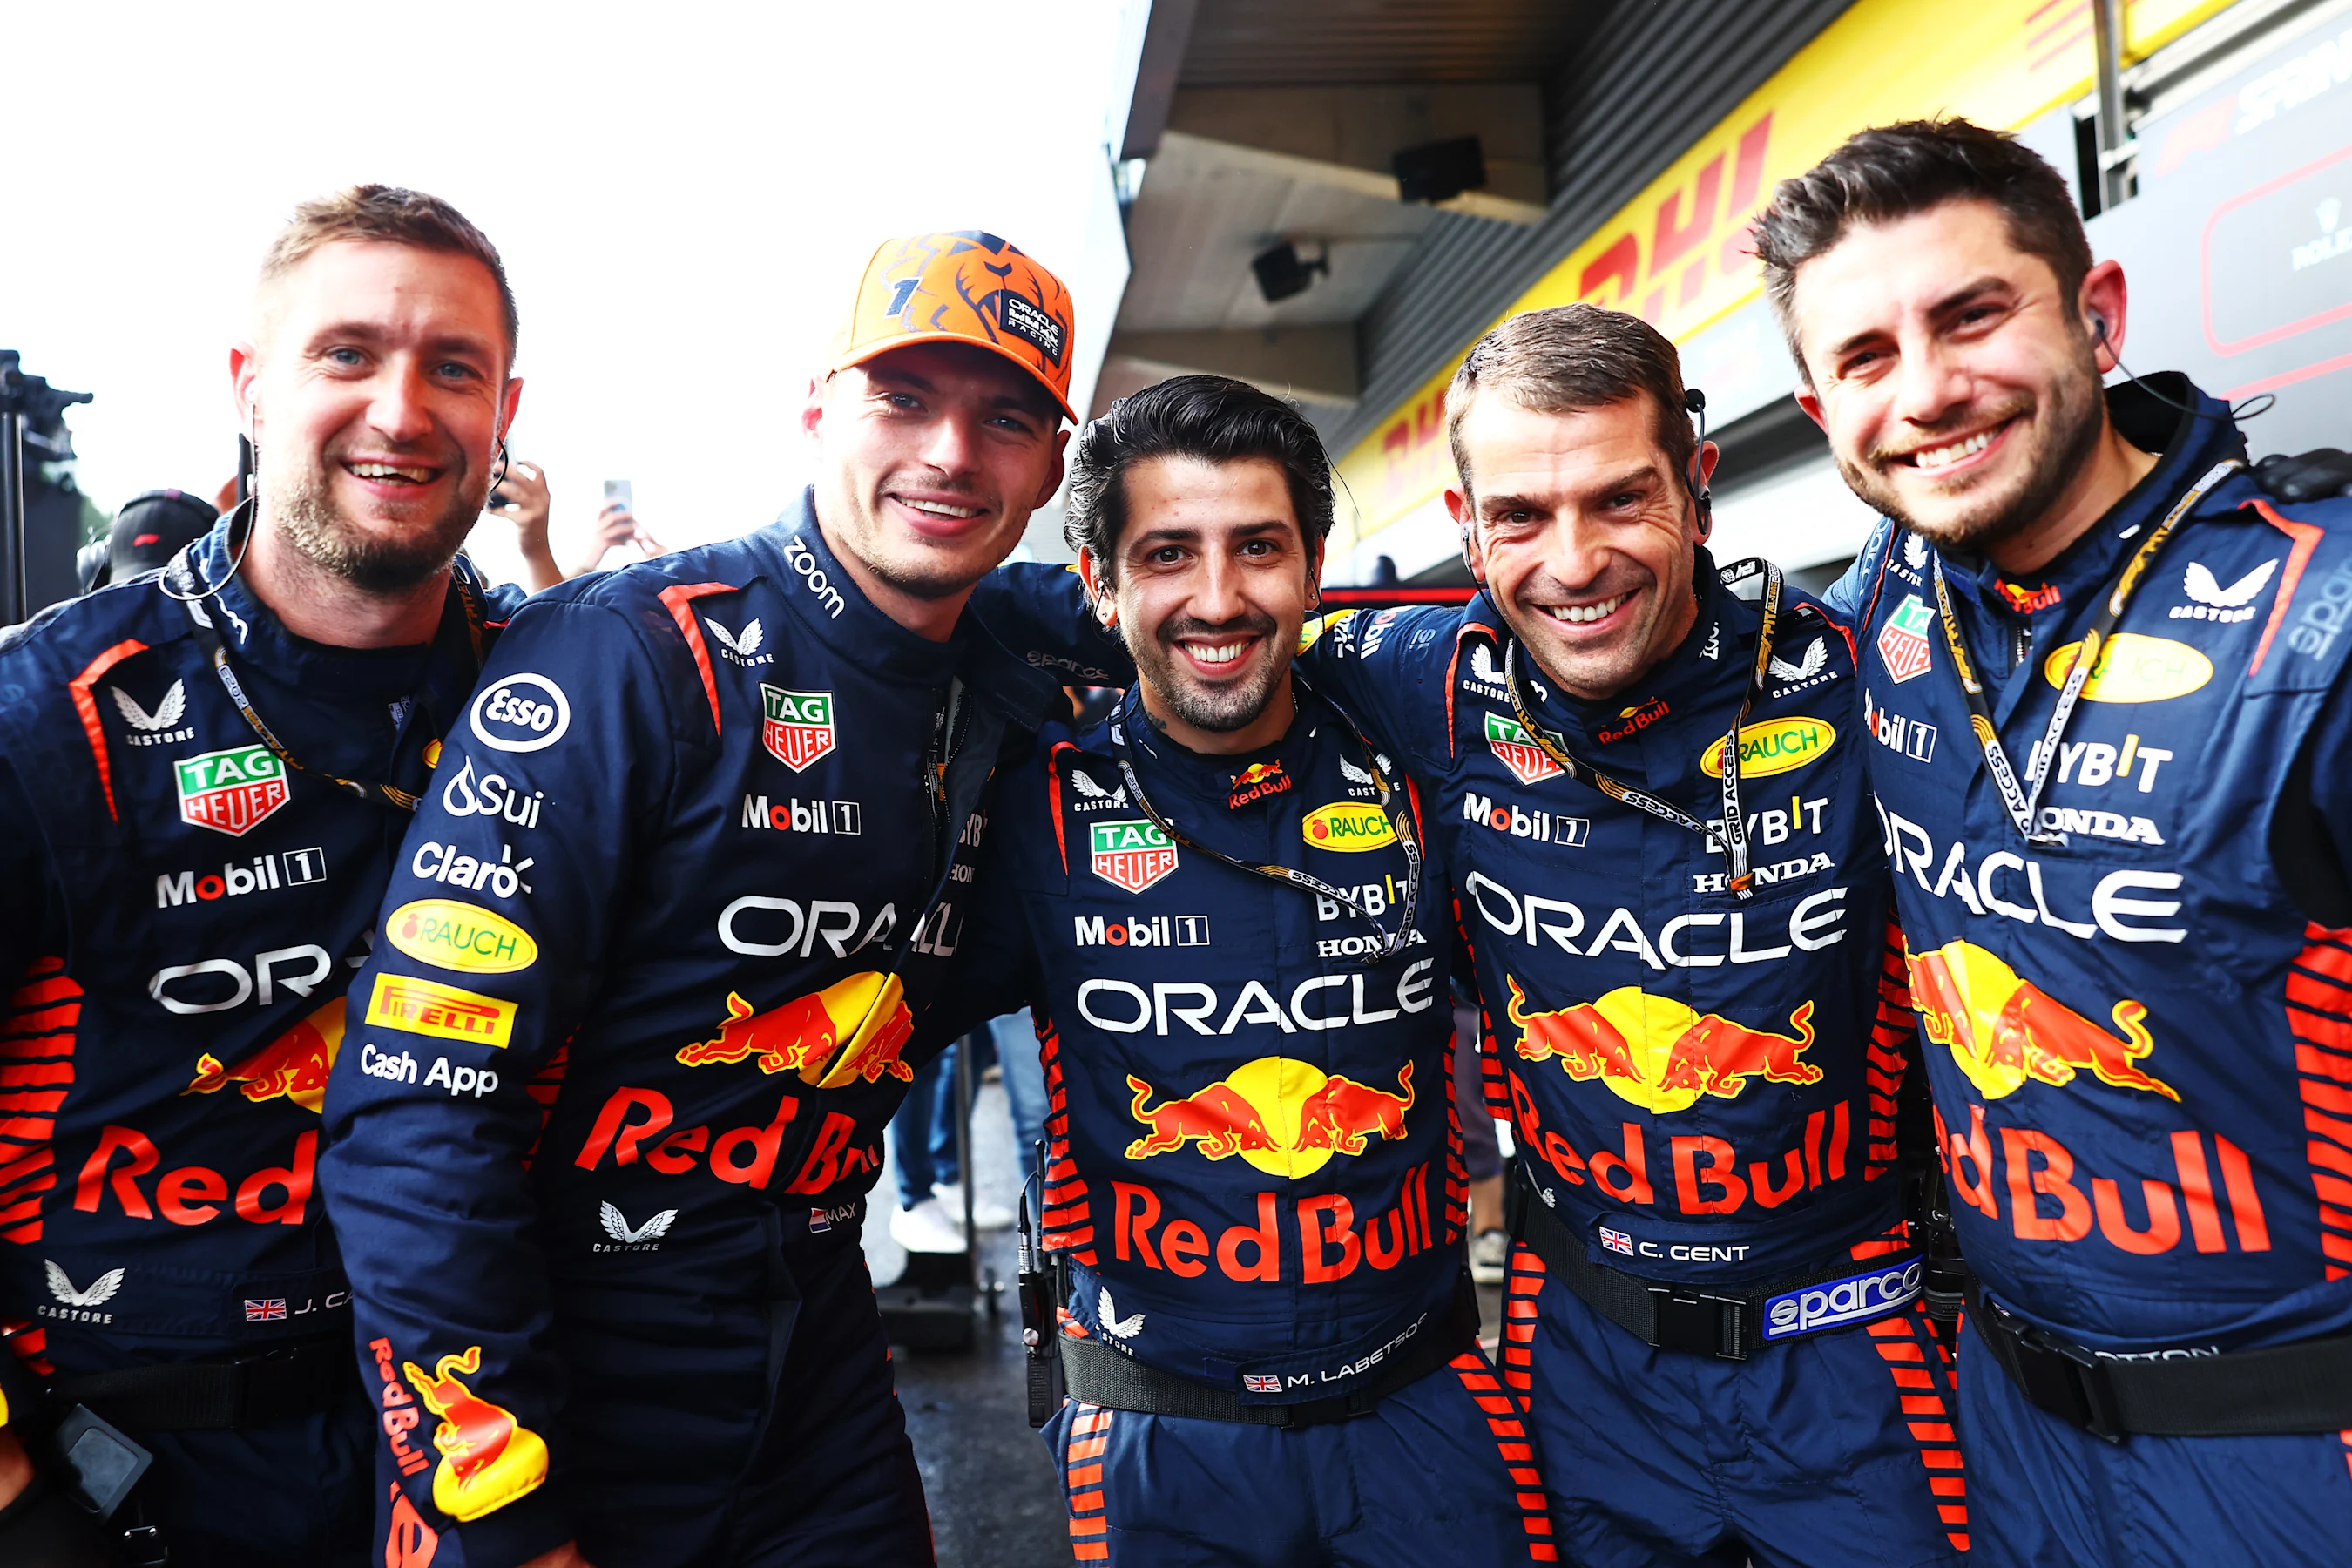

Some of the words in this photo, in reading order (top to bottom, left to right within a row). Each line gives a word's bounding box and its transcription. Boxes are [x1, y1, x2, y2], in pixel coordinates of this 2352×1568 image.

[884, 277, 922, 318] 1
[1009, 299, 1058, 336] ORACLE
[1008, 320, 1058, 355] RACING
[1009, 308, 1025, 322] Red
[1024, 314, 1039, 330] Bull
[784, 537, 845, 618] zoom
[1762, 608, 1776, 637] PIT
[721, 648, 774, 667] CASTORE
[1882, 628, 1931, 674] HEUE
[1463, 680, 1511, 703] CASTORE
[1772, 671, 1838, 698] CASTORE
[767, 693, 824, 721] TAG
[1598, 720, 1635, 744] Red
[1634, 700, 1670, 730] Bull
[2047, 673, 2082, 747] ACCESS
[763, 723, 829, 765] HEUER
[1490, 720, 1540, 747] TA
[184, 748, 273, 789] TAG
[1724, 734, 1736, 801] ACCESS
[1989, 745, 2026, 813] ACCESS
[187, 780, 283, 830] HEUER
[478, 774, 544, 828] Sui
[1228, 781, 1259, 809] Red
[1259, 775, 1292, 800] Bull
[1348, 782, 1401, 796] CASTE
[1626, 793, 1690, 826] ACCESS
[741, 794, 828, 833] Mobil
[1463, 792, 1551, 841] Mobil
[1727, 805, 1744, 845] GRID
[2040, 803, 2166, 845] ONDA
[1096, 826, 1167, 848] TAG
[157, 855, 277, 909] Mobil
[412, 841, 520, 899] Claro
[1097, 848, 1173, 891] HEUER
[1403, 843, 1419, 902] ACCESS
[1693, 852, 1835, 893] HNDA
[422, 914, 517, 962] RAUCH
[1075, 916, 1169, 947] Mobil
[1398, 906, 1414, 940] GRID
[1465, 871, 1848, 970] ORACLE
[1316, 929, 1428, 957] HONA
[380, 985, 499, 1036] PIRELLI
[1078, 957, 1435, 1035] ORACLE
[361, 1044, 416, 1084] Cash
[423, 1055, 498, 1098] App
[574, 1085, 798, 1191] Red
[1508, 1068, 1654, 1206] Red
[1670, 1099, 1851, 1215] Bull
[72, 1124, 318, 1226] Red
[2000, 1129, 2272, 1254] Bull
[825, 1202, 855, 1222] MAX
[1111, 1180, 1280, 1282] Red
[1297, 1161, 1432, 1284] Bull
[593, 1242, 660, 1253] CASTORE
[1639, 1243, 1663, 1259] C.
[1670, 1246, 1749, 1262] GENT
[37, 1304, 112, 1325] CASTORE
[294, 1298, 318, 1314] J.
[1769, 1262, 1923, 1331] sparco
[1097, 1326, 1134, 1356] STORE
[369, 1337, 414, 1408] Red
[1287, 1371, 1315, 1388] M.
[382, 1406, 429, 1477] Bull
